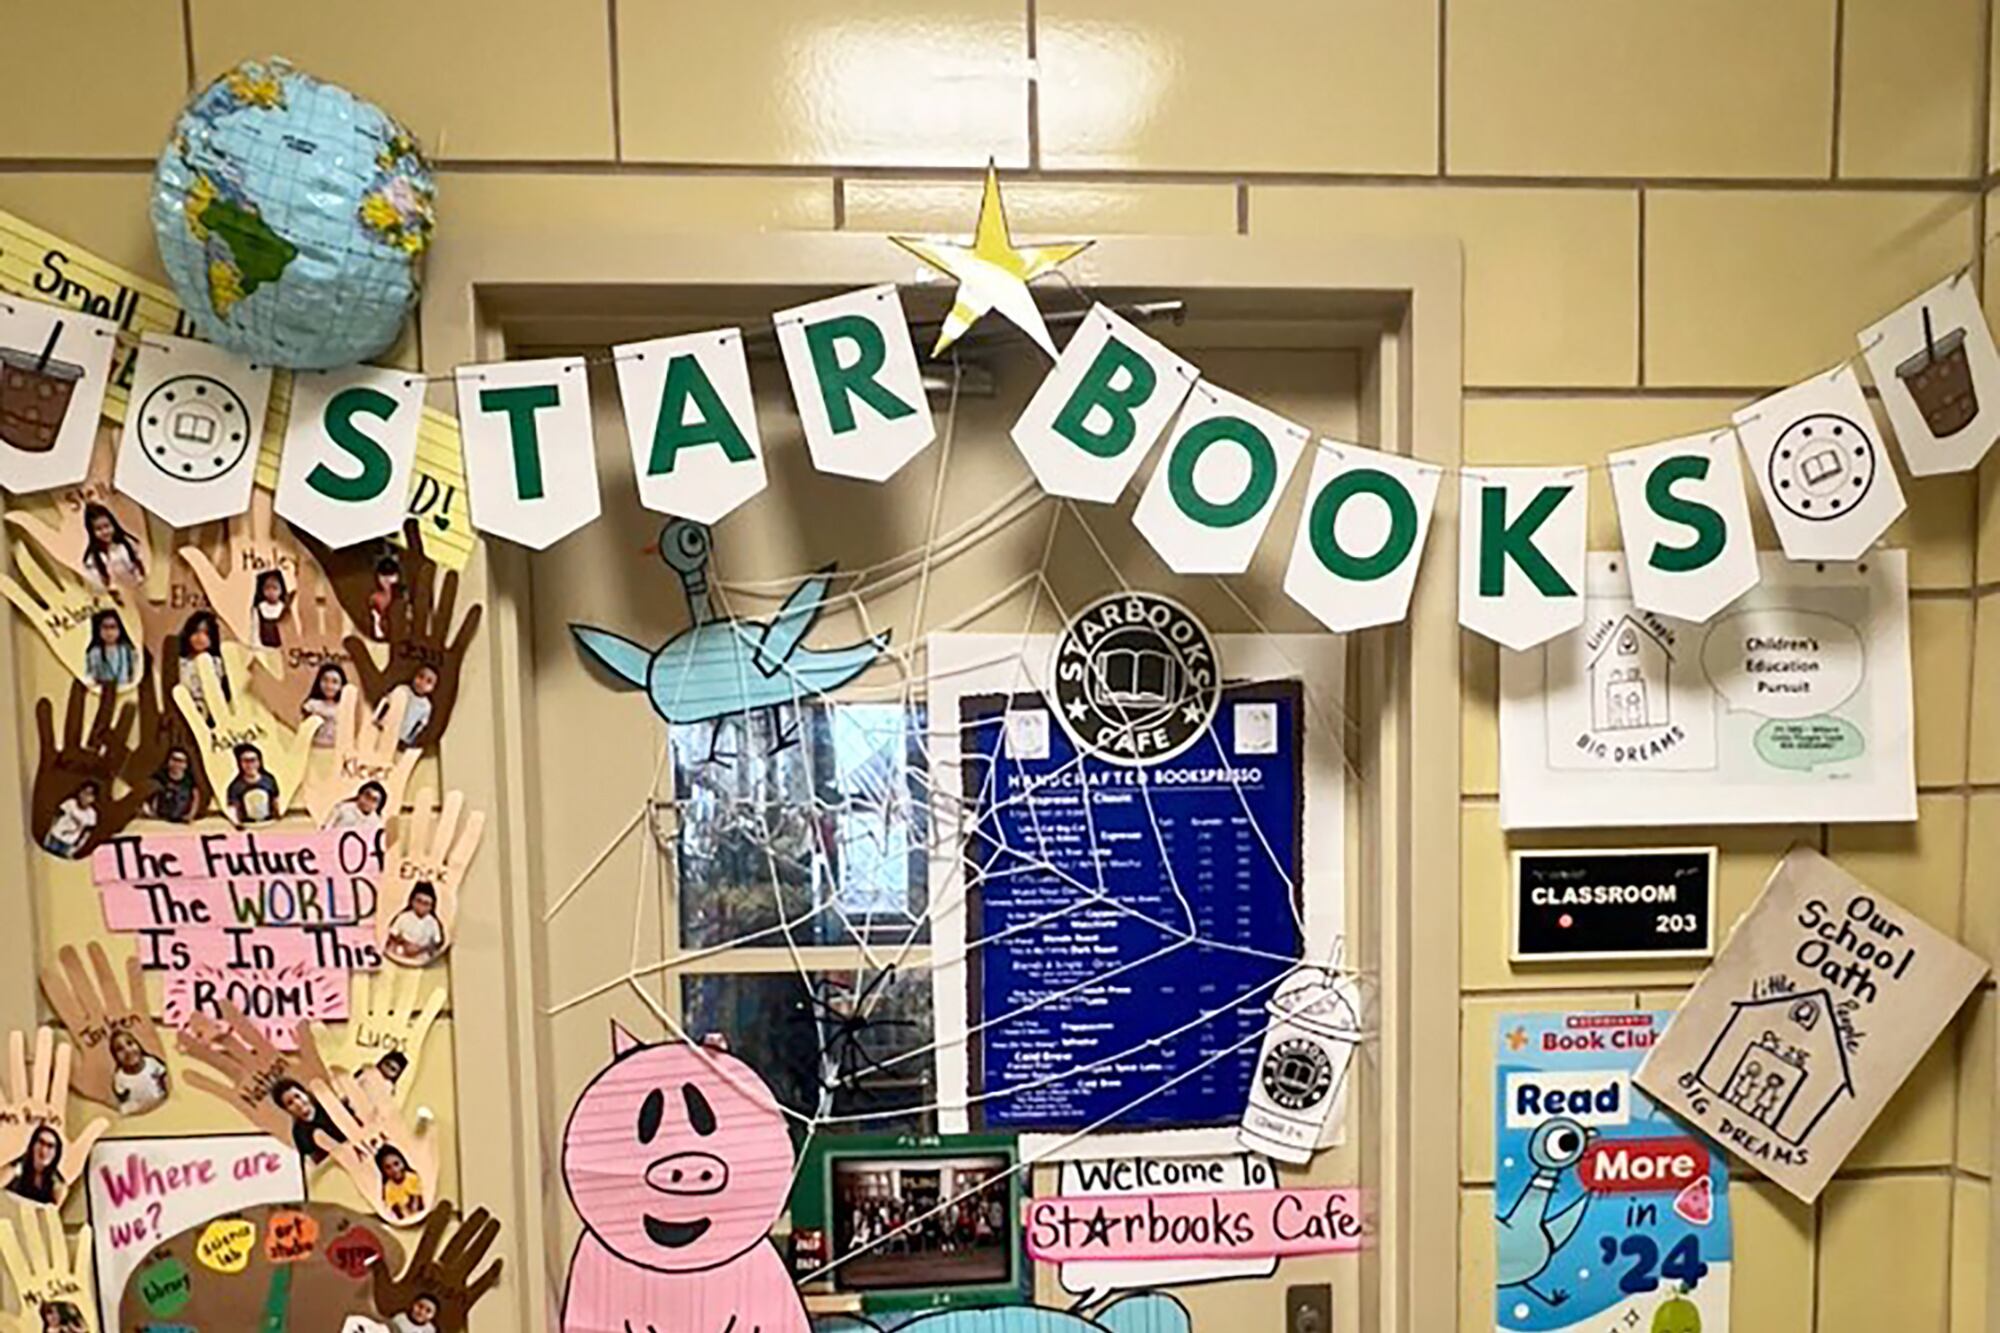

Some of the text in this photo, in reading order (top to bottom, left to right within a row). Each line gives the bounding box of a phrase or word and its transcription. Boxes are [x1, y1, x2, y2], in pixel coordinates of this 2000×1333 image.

[1060, 599, 1211, 688] STARBOOKS
[1745, 637, 1820, 652] Children's
[1745, 659, 1820, 673] Education
[1757, 680, 1811, 693] Pursuit
[1097, 726, 1171, 753] CAFE
[1614, 725, 1685, 763] DREAMS
[102, 826, 386, 880] The Future Of
[134, 876, 379, 926] The WORLD
[1531, 884, 1678, 905] CLASSROOM
[1655, 914, 1697, 933] 203
[1846, 895, 1904, 940] Our
[139, 924, 385, 971] Is In This
[1797, 900, 1916, 980] School
[1796, 939, 1878, 1004] Oath
[193, 979, 315, 1018] ROOM!
[1542, 1030, 1606, 1051] Book
[1516, 1080, 1620, 1116] Read
[1677, 1071, 1809, 1166] BIG DREAMS
[99, 1151, 283, 1208] Where are
[1072, 1154, 1266, 1191] Welcome To
[1593, 1149, 1697, 1182] More
[109, 1201, 162, 1249] we?
[1272, 1193, 1363, 1241] Cafe
[1625, 1197, 1657, 1228] in
[1598, 1232, 1709, 1295] '24
